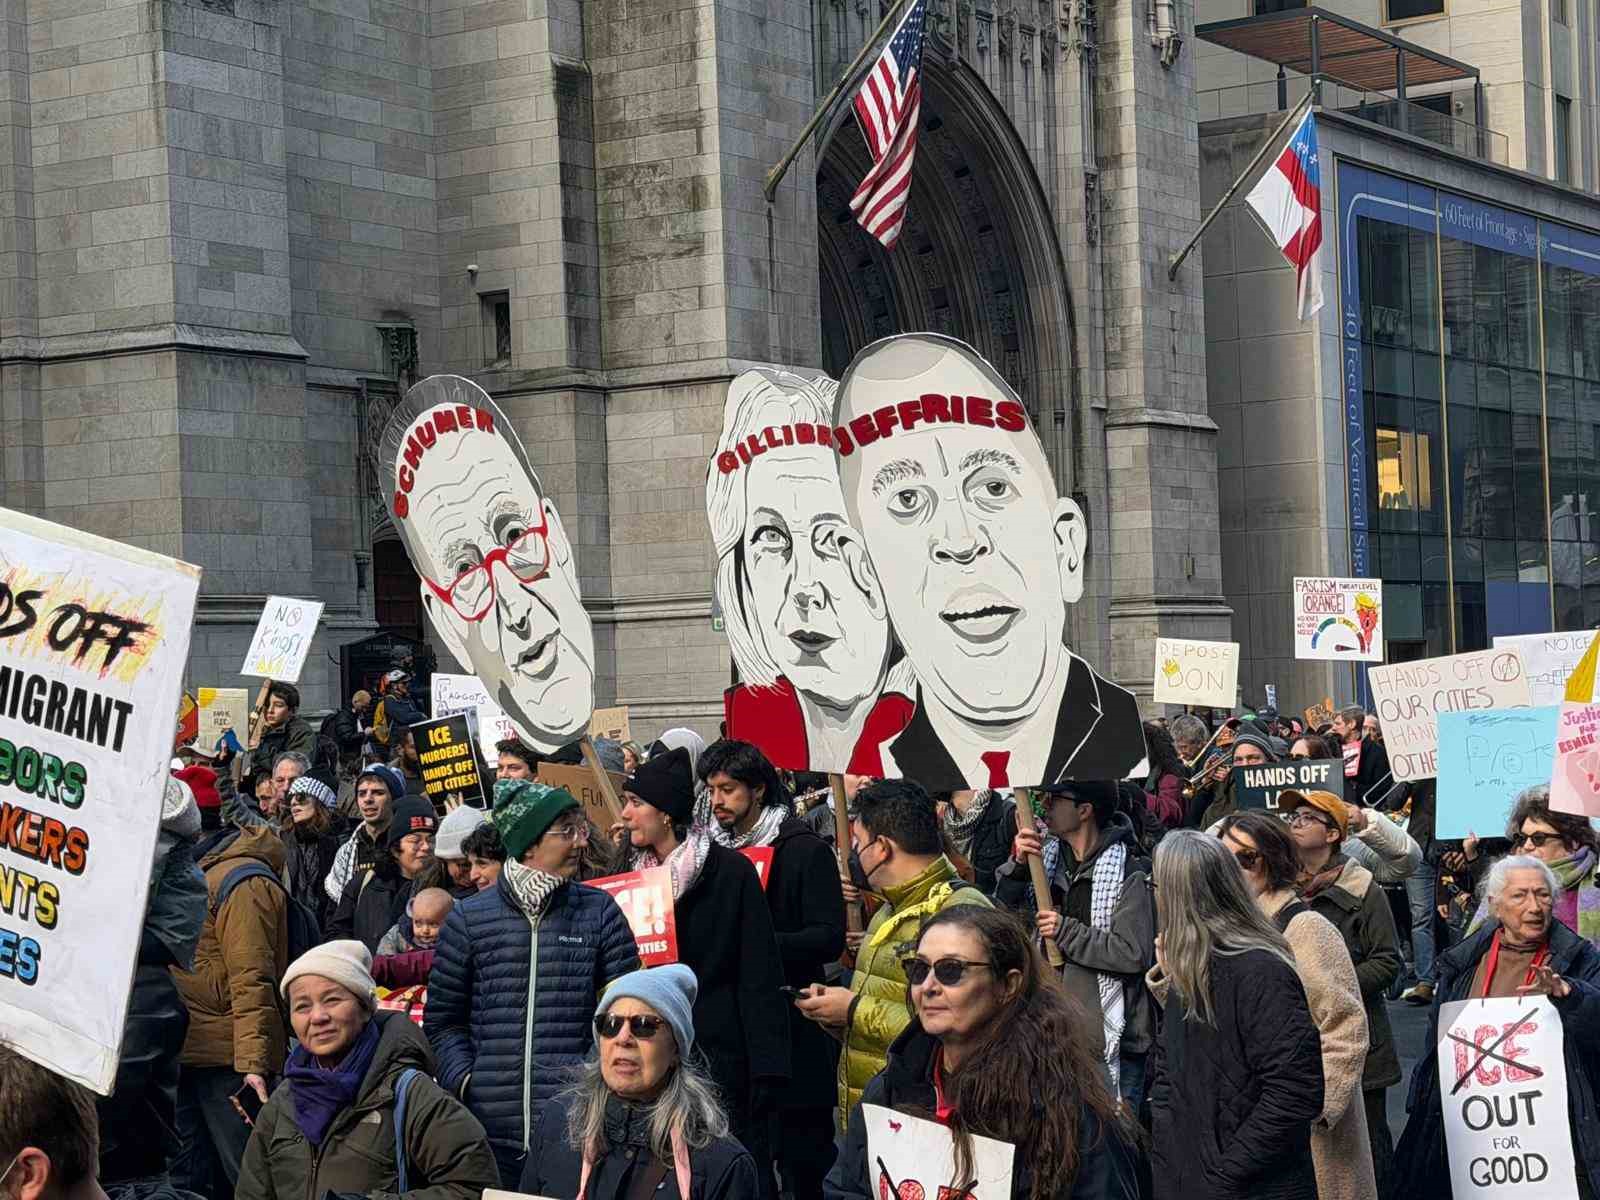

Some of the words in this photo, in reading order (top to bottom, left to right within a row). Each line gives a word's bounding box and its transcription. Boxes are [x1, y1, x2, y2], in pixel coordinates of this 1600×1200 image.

[834, 394, 1025, 457] JEFFRIES
[393, 405, 495, 520] SCHUMER
[1295, 579, 1337, 593] FASCISM
[1358, 583, 1378, 591] LEVEL
[1305, 595, 1344, 612] ORANGE
[48, 603, 154, 672] OFF
[1544, 638, 1566, 652] NO
[1160, 642, 1233, 659] DEPOSE
[1168, 668, 1224, 691] DON
[1376, 664, 1441, 694] HANDS
[1453, 657, 1485, 681] OFF
[1380, 694, 1429, 721] OUR
[1433, 686, 1494, 712] CITIES
[428, 725, 452, 746] ICE
[420, 742, 469, 765] MURDERS!
[423, 764, 453, 781] HANDS
[454, 760, 473, 774] OFF
[1244, 767, 1296, 788] HANDS
[1299, 764, 1331, 784] OFF
[426, 781, 444, 795] OUR
[445, 773, 478, 790] CITIES!
[1453, 1022, 1543, 1088] ICE
[1462, 1090, 1543, 1131] OUT
[1493, 1136, 1521, 1150] FOR
[1469, 1153, 1548, 1188] GOOD
